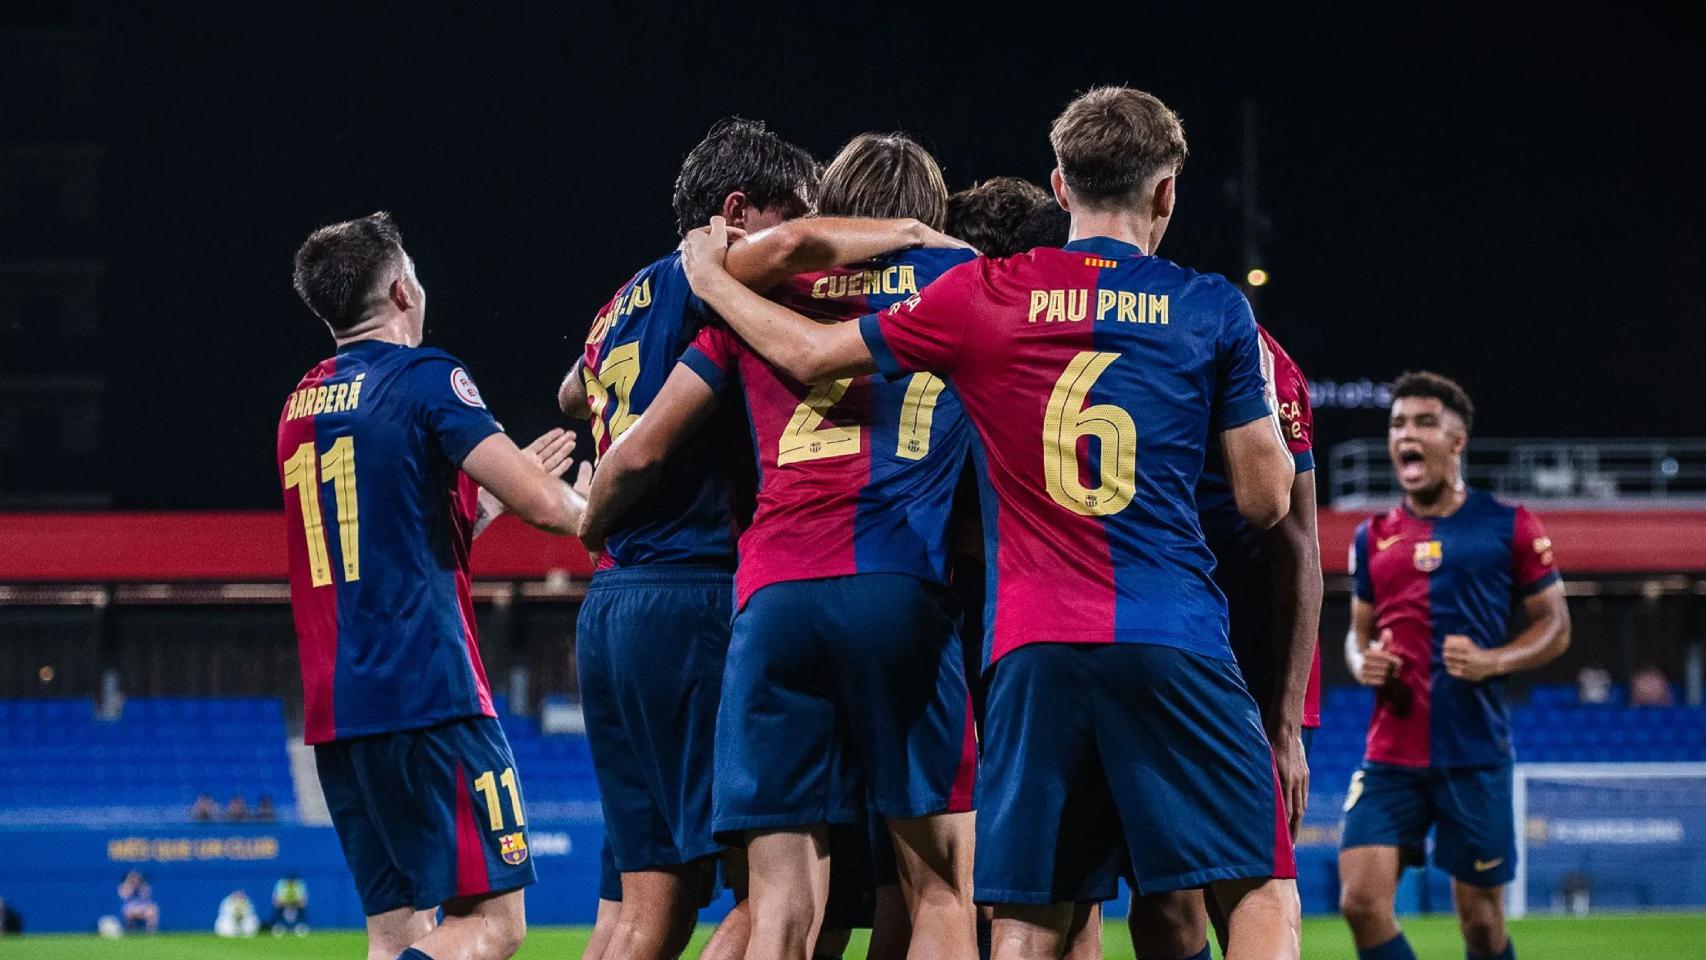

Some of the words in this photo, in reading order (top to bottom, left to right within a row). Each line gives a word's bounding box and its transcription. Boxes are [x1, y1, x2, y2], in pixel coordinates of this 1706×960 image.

[811, 265, 917, 299] CUENCA
[1028, 289, 1088, 323] PAU
[1096, 289, 1169, 324] PRIM
[286, 373, 365, 421] BARBERÁ
[1042, 351, 1137, 516] 6
[283, 436, 361, 588] 11
[474, 767, 525, 831] 11
